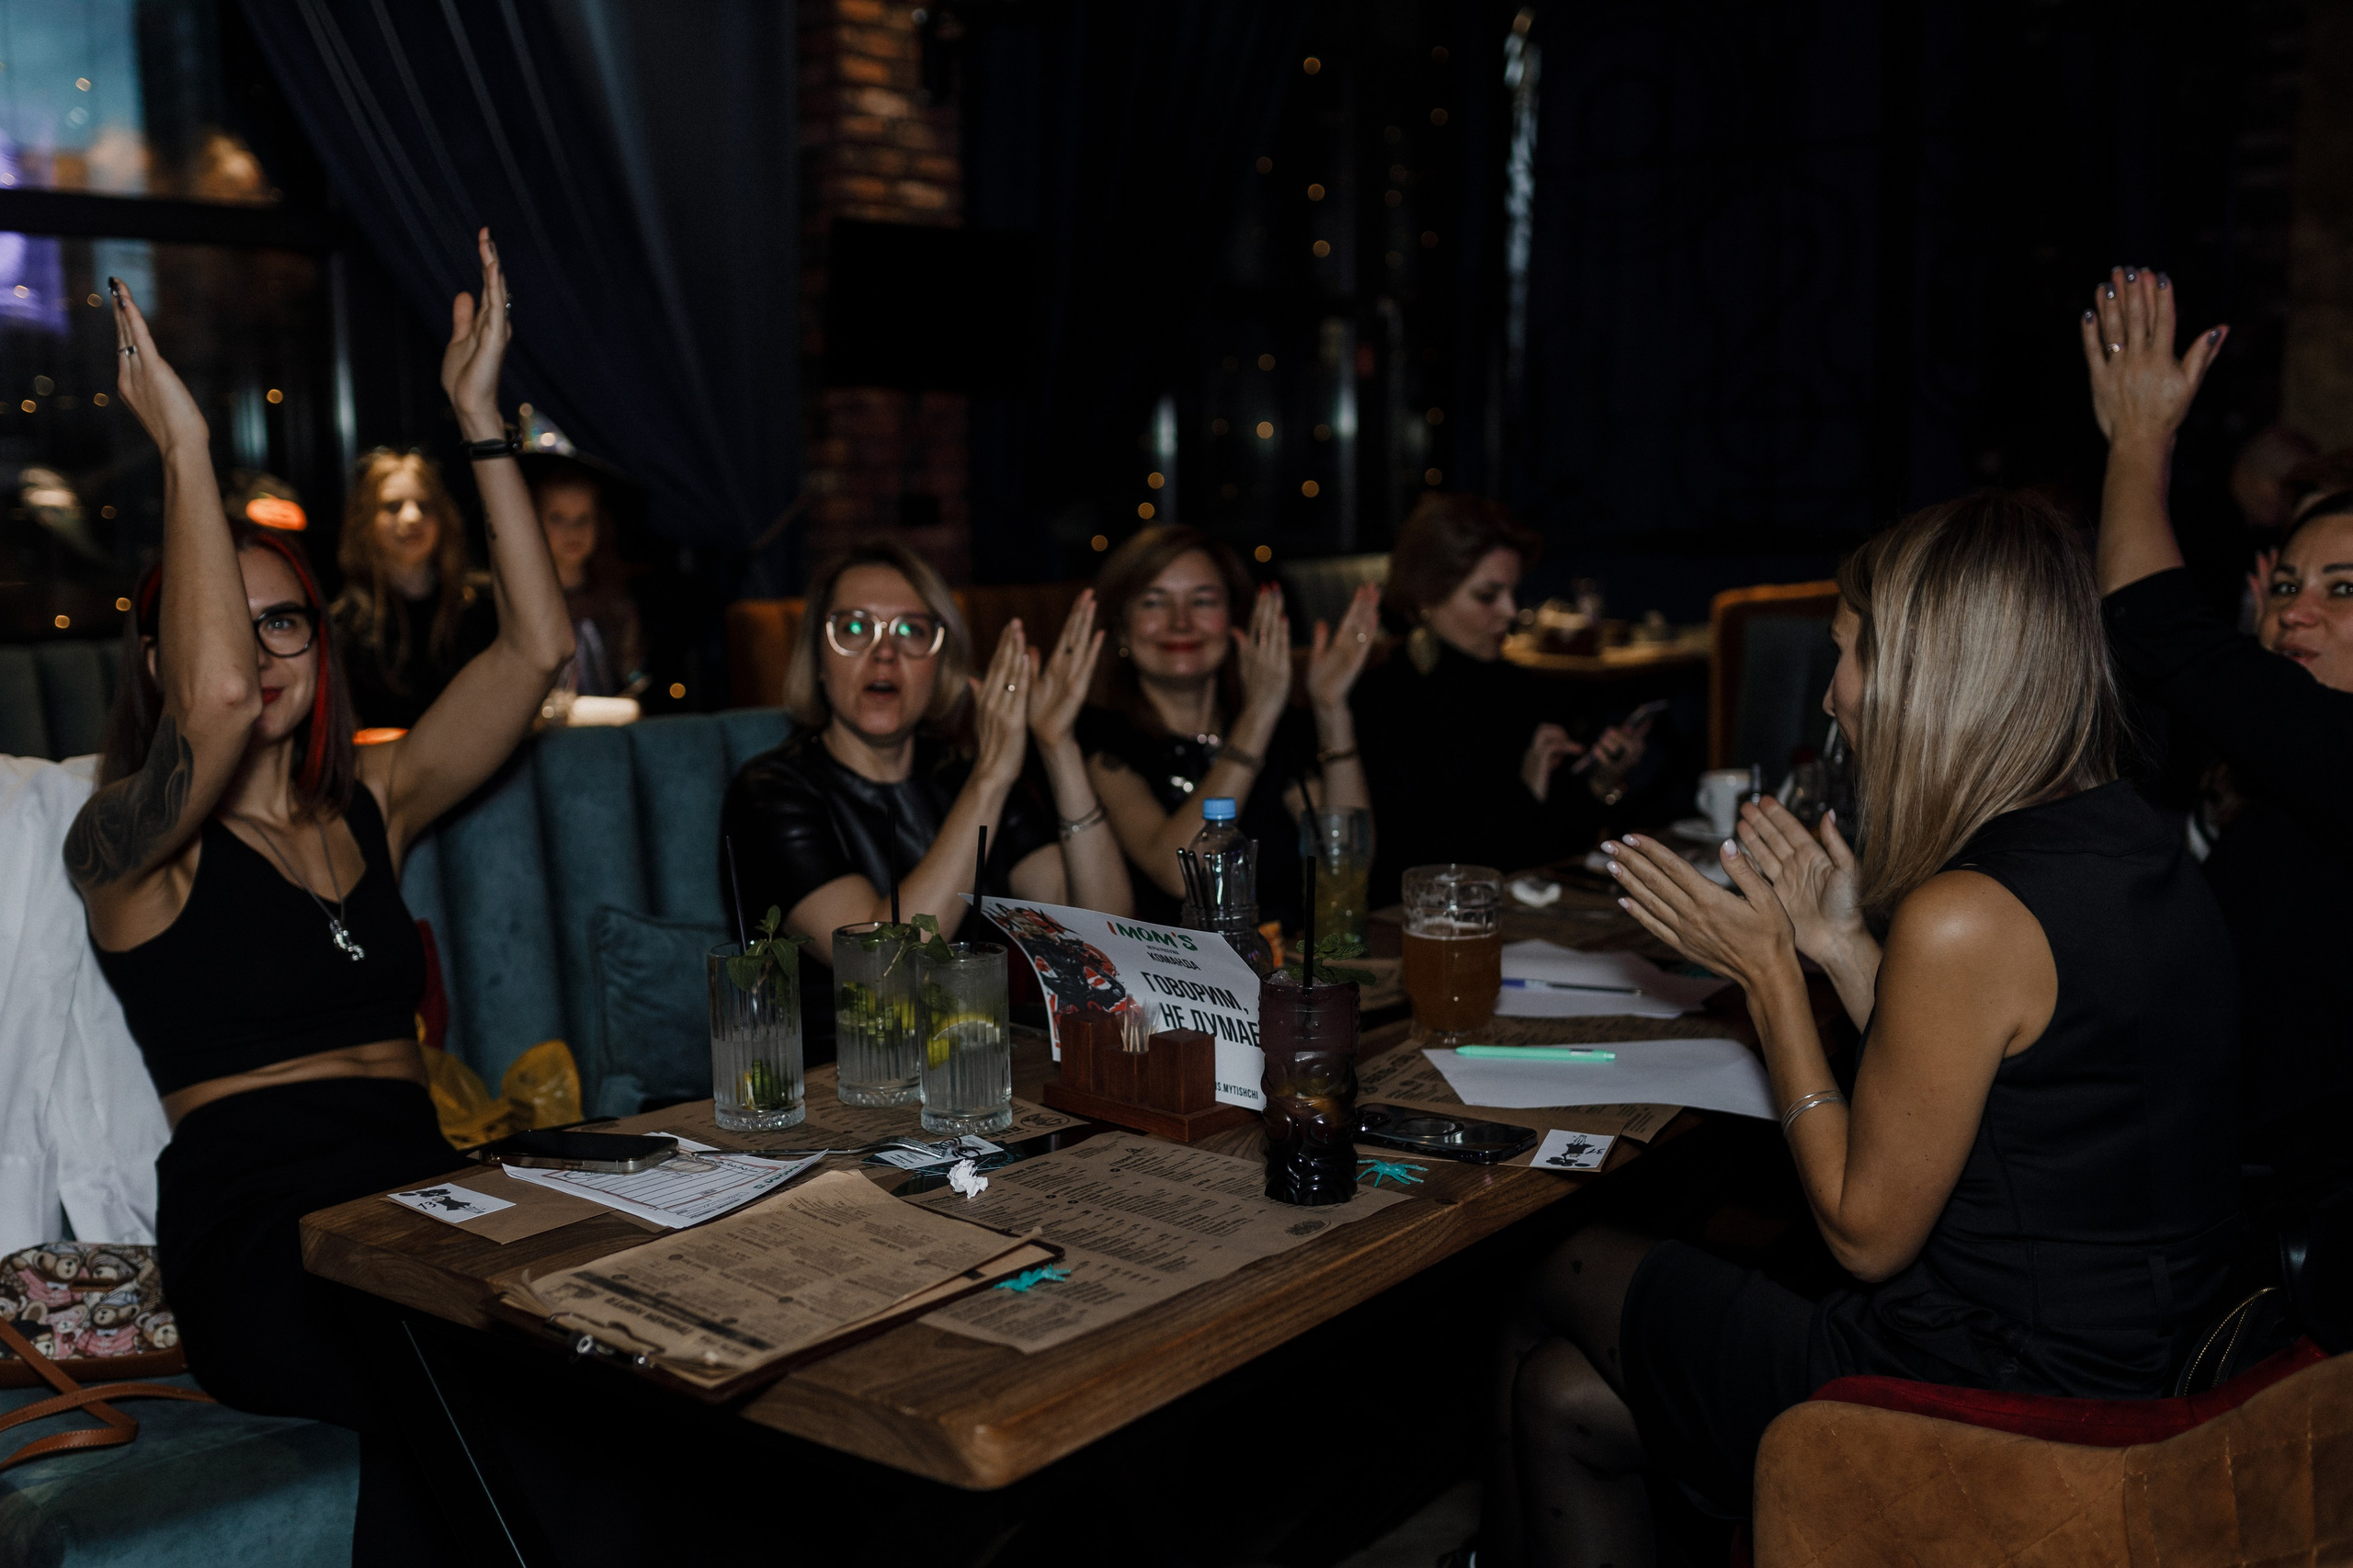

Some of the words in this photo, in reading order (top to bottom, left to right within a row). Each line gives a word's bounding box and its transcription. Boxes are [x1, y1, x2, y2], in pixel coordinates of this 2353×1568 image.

[1146, 951, 1201, 971] КОМАНДА
[1141, 971, 1249, 1015] ГОВОРИМ,
[1159, 1002, 1187, 1029] НЕ
[1190, 1008, 1260, 1048] ДУМАЕ
[1215, 1082, 1259, 1099] S.MYTISHCHI
